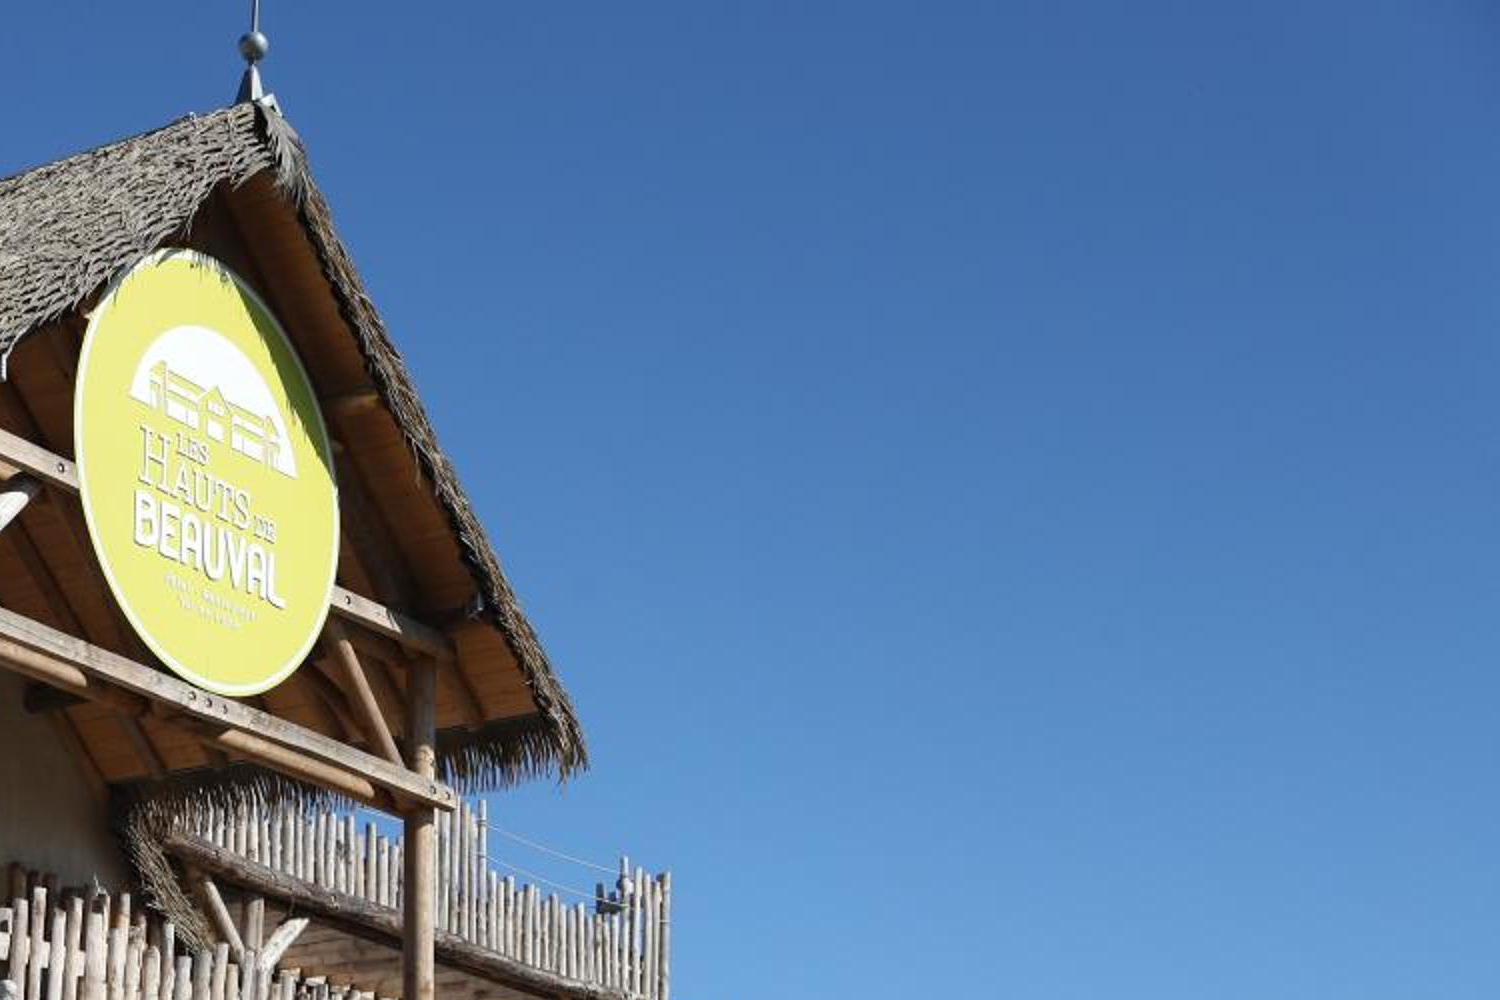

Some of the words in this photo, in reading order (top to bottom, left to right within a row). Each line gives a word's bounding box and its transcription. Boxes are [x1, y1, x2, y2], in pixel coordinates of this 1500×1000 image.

[138, 425, 251, 530] HAUTS
[175, 432, 209, 467] LES
[134, 490, 287, 610] BEAUVAL
